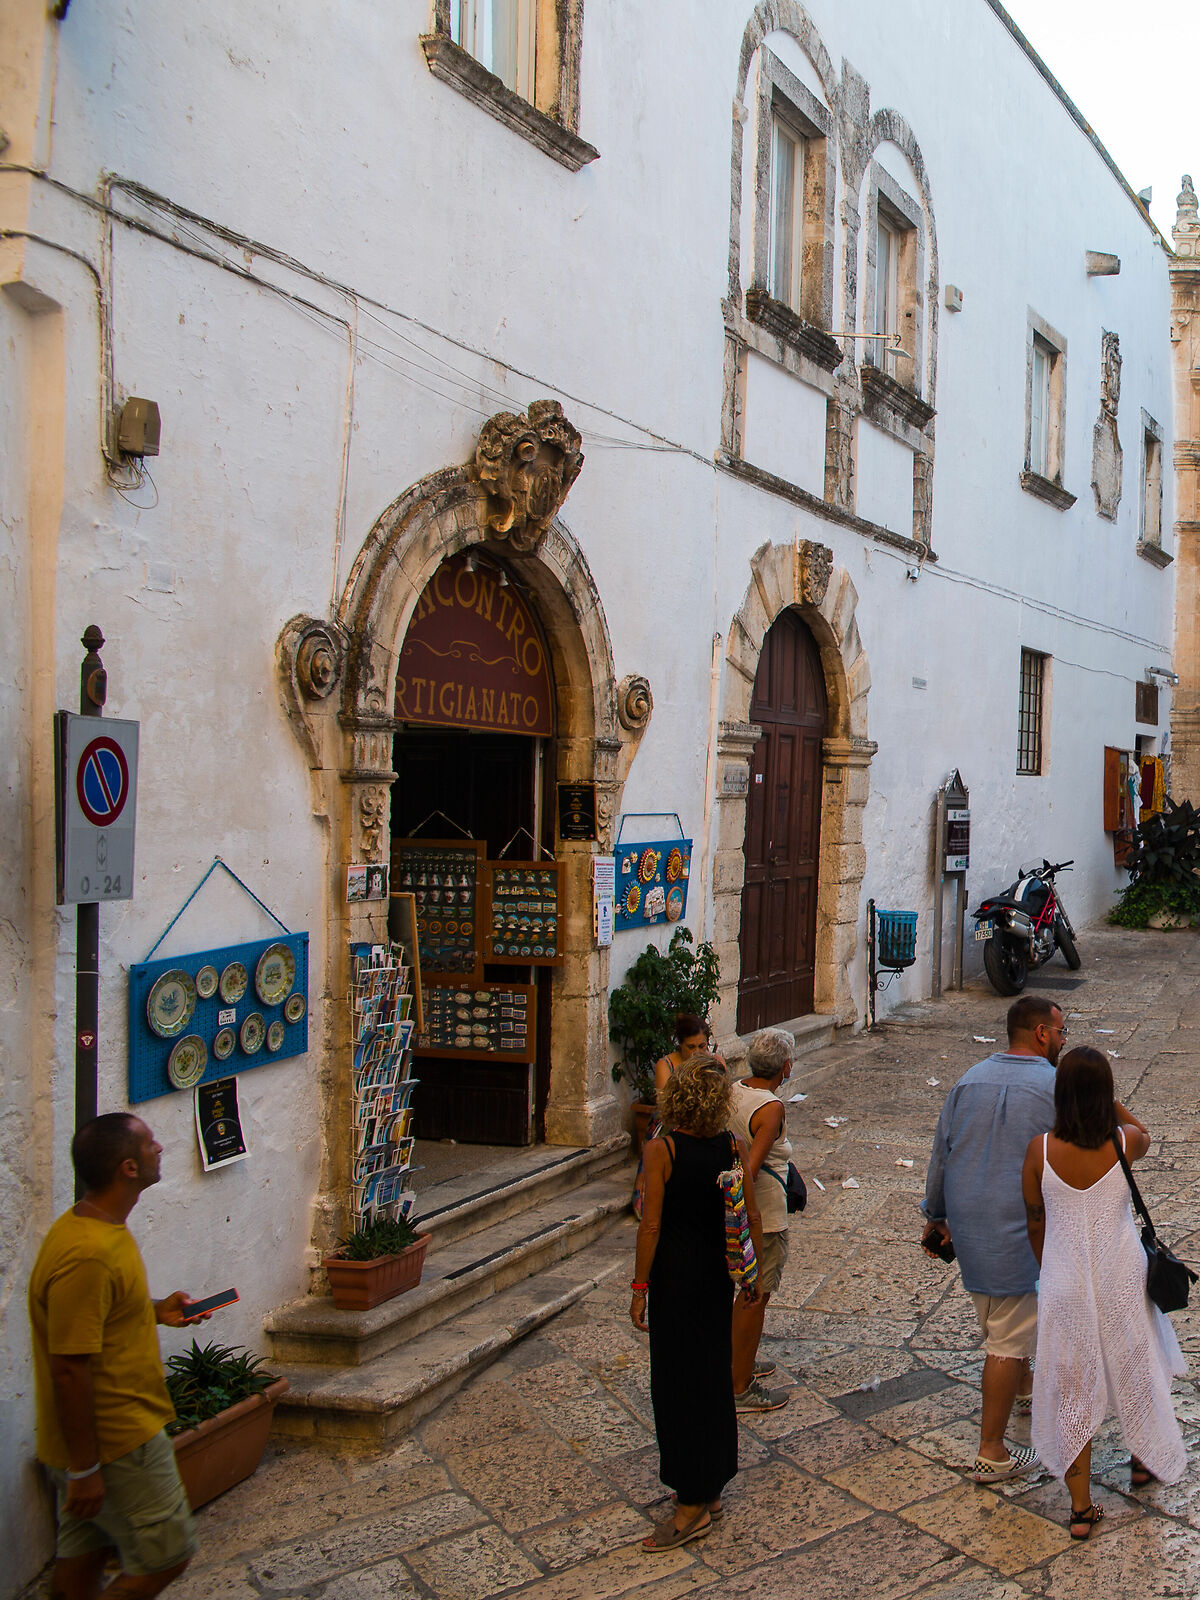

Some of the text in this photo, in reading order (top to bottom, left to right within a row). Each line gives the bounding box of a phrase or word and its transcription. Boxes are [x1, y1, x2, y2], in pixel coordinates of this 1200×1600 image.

[409, 565, 542, 676] NCONTRO
[81, 876, 90, 895] 0
[104, 875, 122, 894] 24
